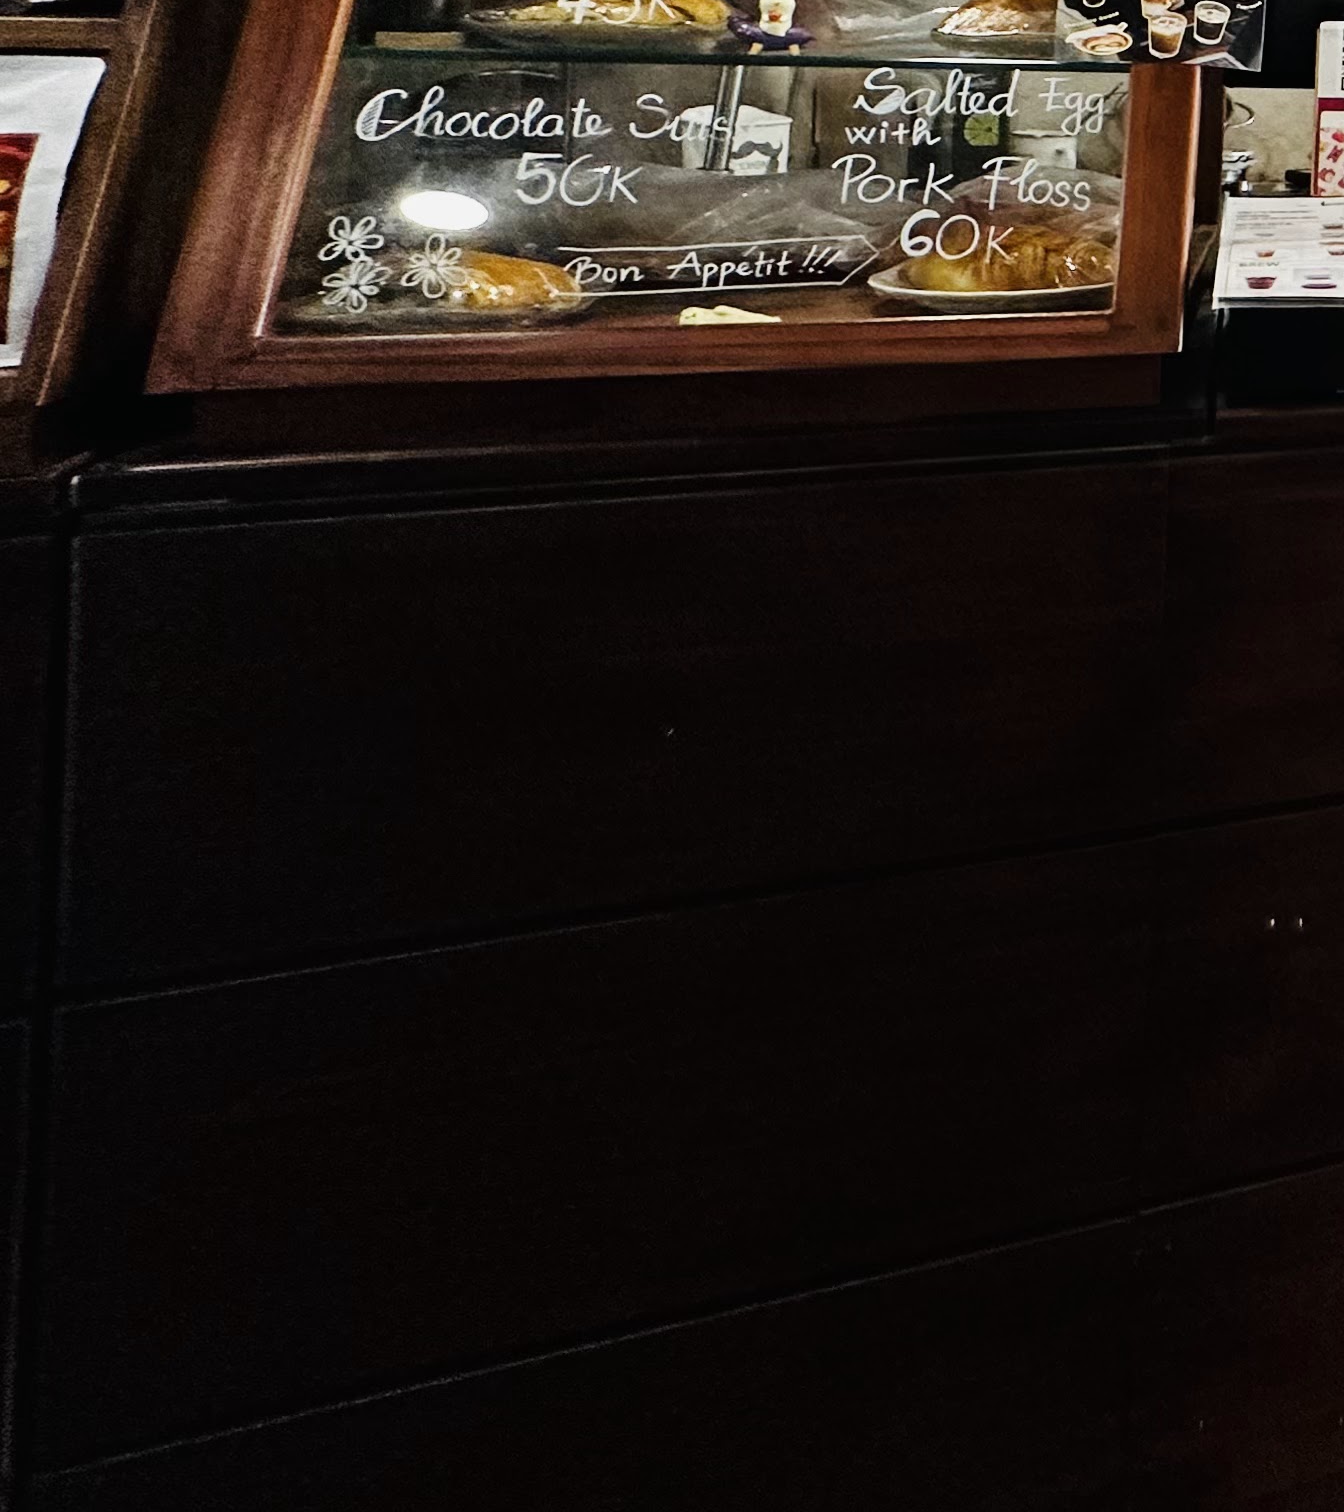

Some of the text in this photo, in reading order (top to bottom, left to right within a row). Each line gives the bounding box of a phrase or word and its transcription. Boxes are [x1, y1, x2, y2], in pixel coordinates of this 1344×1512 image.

[354, 84, 613, 142] Chocolate
[852, 66, 1106, 136] Salted Egg
[844, 117, 942, 146] with
[831, 152, 1092, 212] Pork Floss
[562, 255, 645, 285] Bon
